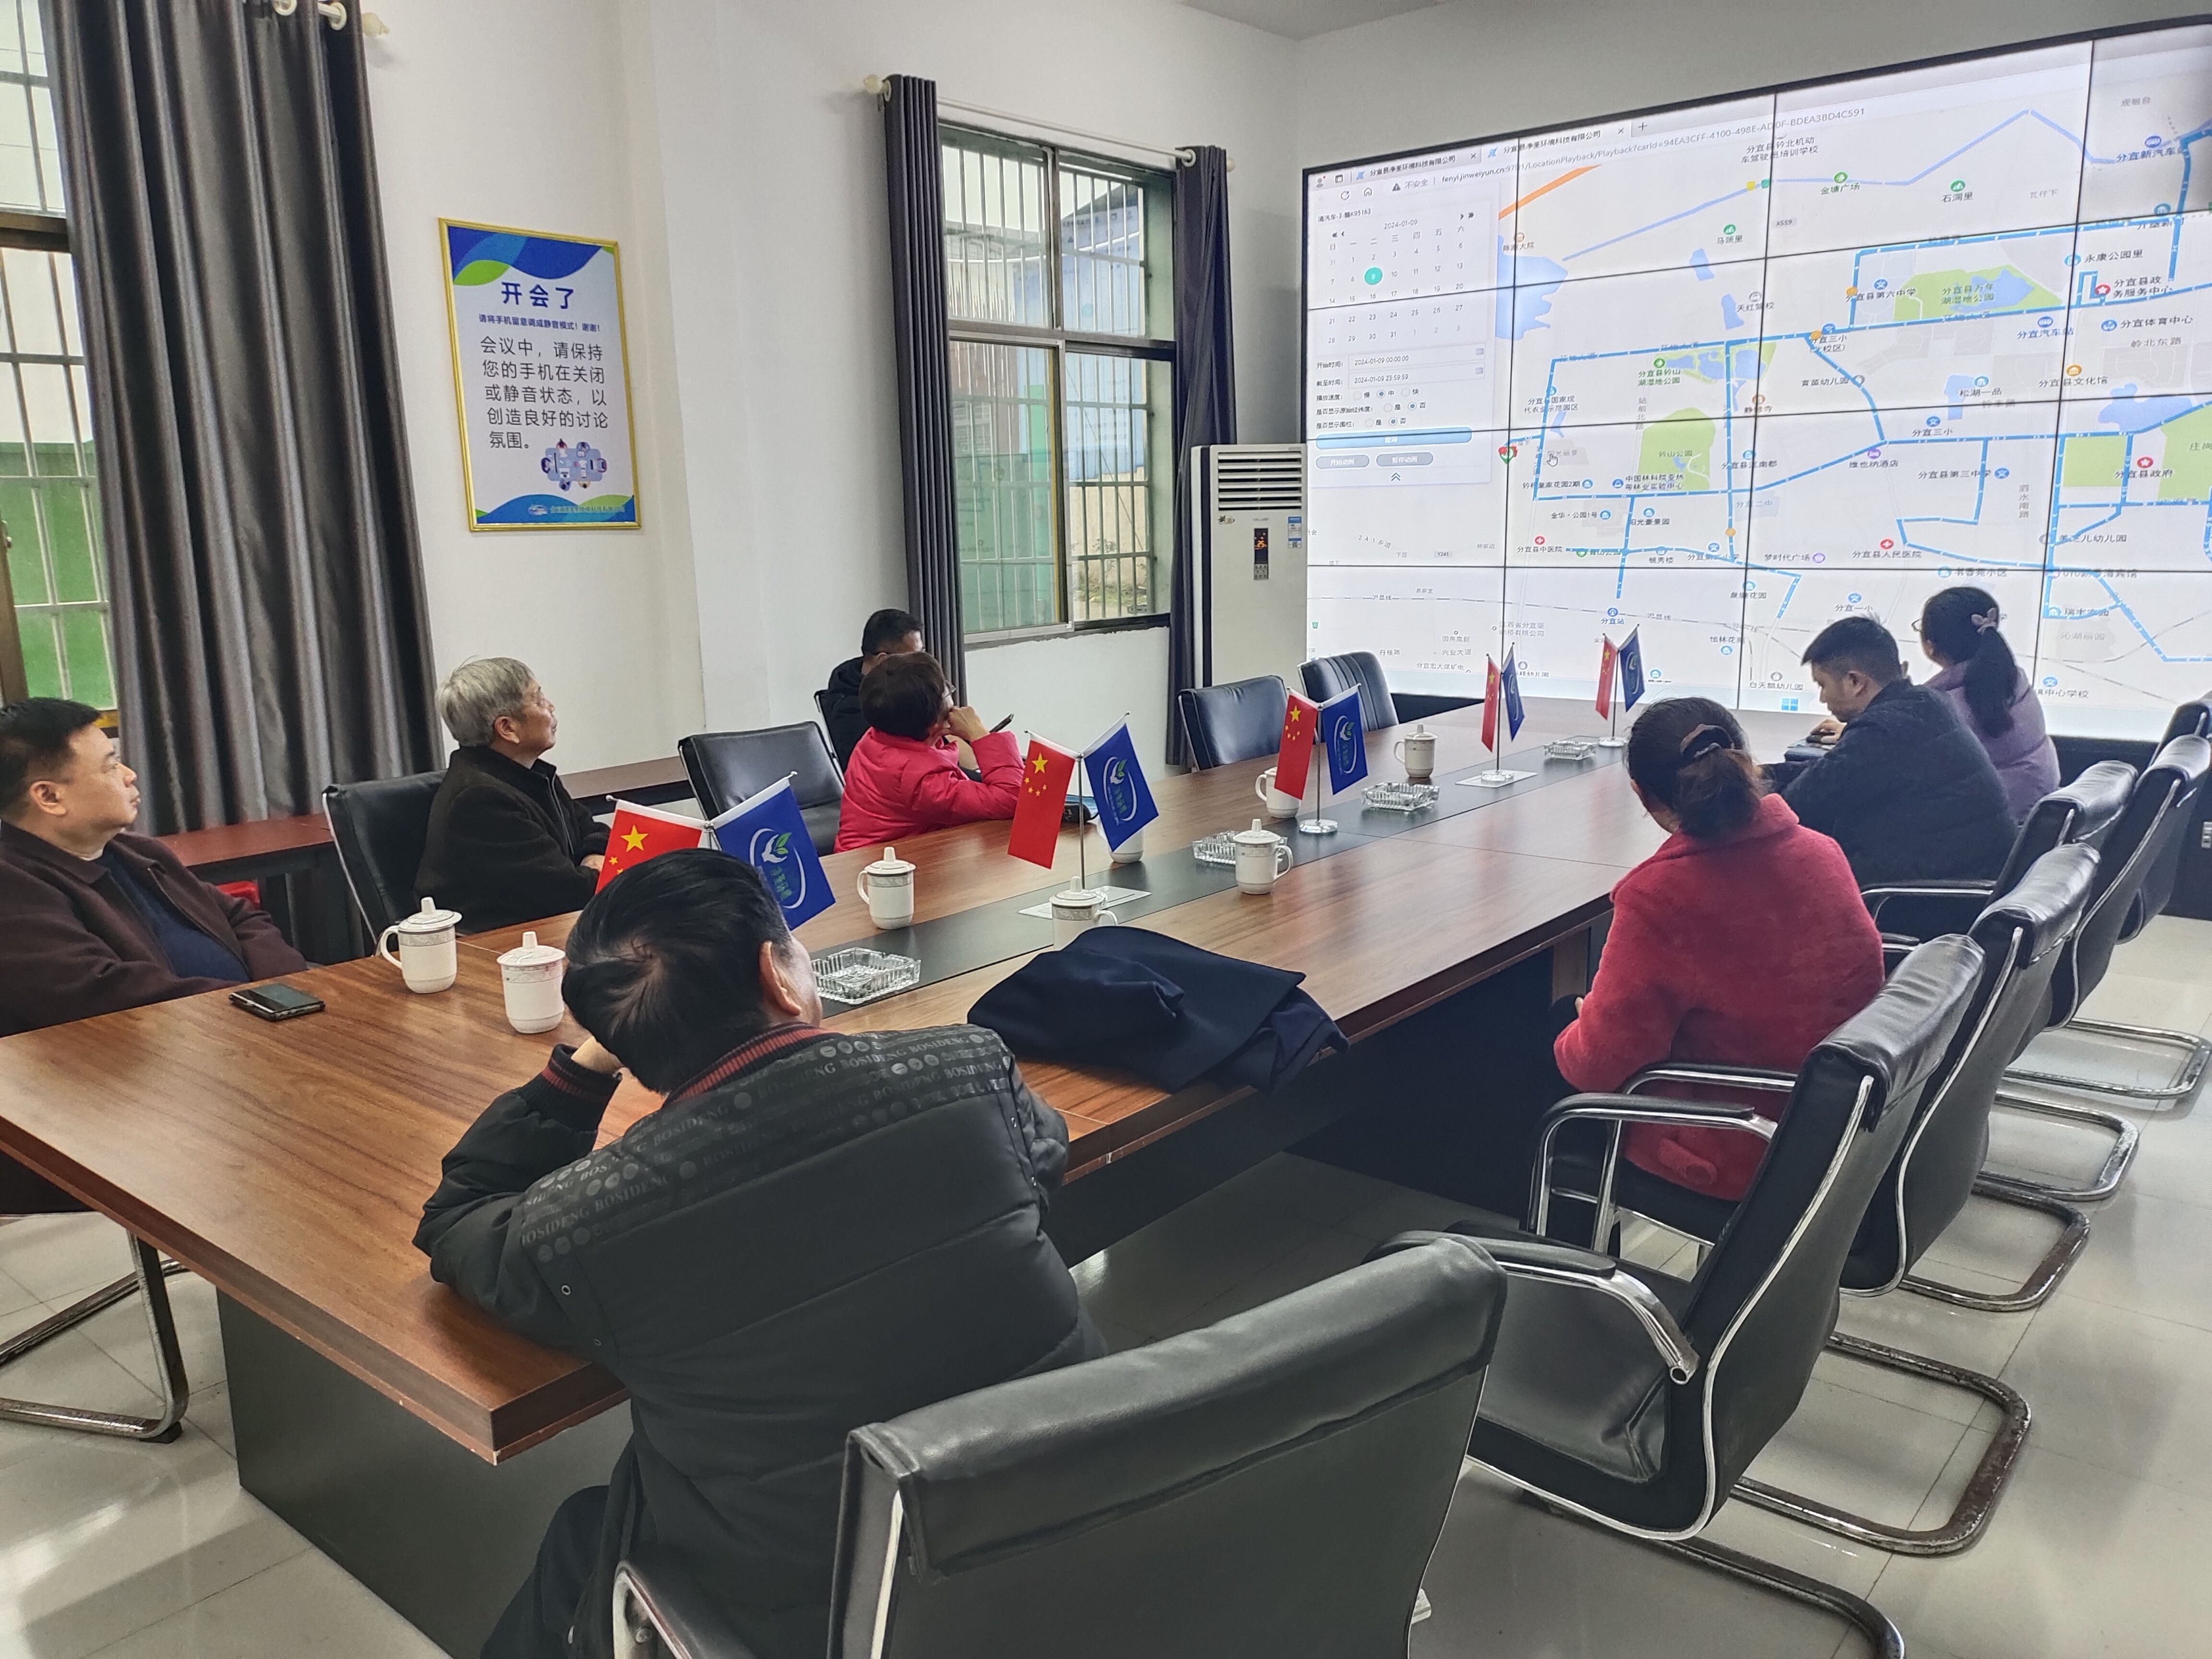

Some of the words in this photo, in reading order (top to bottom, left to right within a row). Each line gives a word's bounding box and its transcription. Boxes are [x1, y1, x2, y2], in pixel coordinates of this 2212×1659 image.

[1405, 179, 1428, 188] 不安全
[1384, 219, 1418, 229] 2024-01-09
[1391, 234, 1399, 242] 三
[1413, 231, 1420, 240] 四
[1457, 225, 1465, 234] 六
[2084, 249, 2143, 263] 永康公园里
[2114, 276, 2161, 288] 分宜县政
[501, 281, 574, 309] 开会了
[2120, 315, 2193, 329] 分宜体育中心
[2017, 327, 2074, 339] 分宜汽车站
[481, 336, 603, 361] 会议中，请保持
[482, 360, 604, 383] 您的手机在关闭
[2038, 376, 2108, 388] 分宜县文化馆
[485, 385, 606, 407] 或静音状态，以
[1960, 387, 2002, 397] 松湖一品
[487, 407, 608, 429] 创造良好的讨论
[1912, 428, 1953, 437] 分宜三小
[489, 431, 529, 449] 氛围。
[2115, 470, 2173, 479] 分宜县政府
[1852, 551, 1922, 559] 分宜县人民医院
[908, 1035, 970, 1054] BOSIDENG
